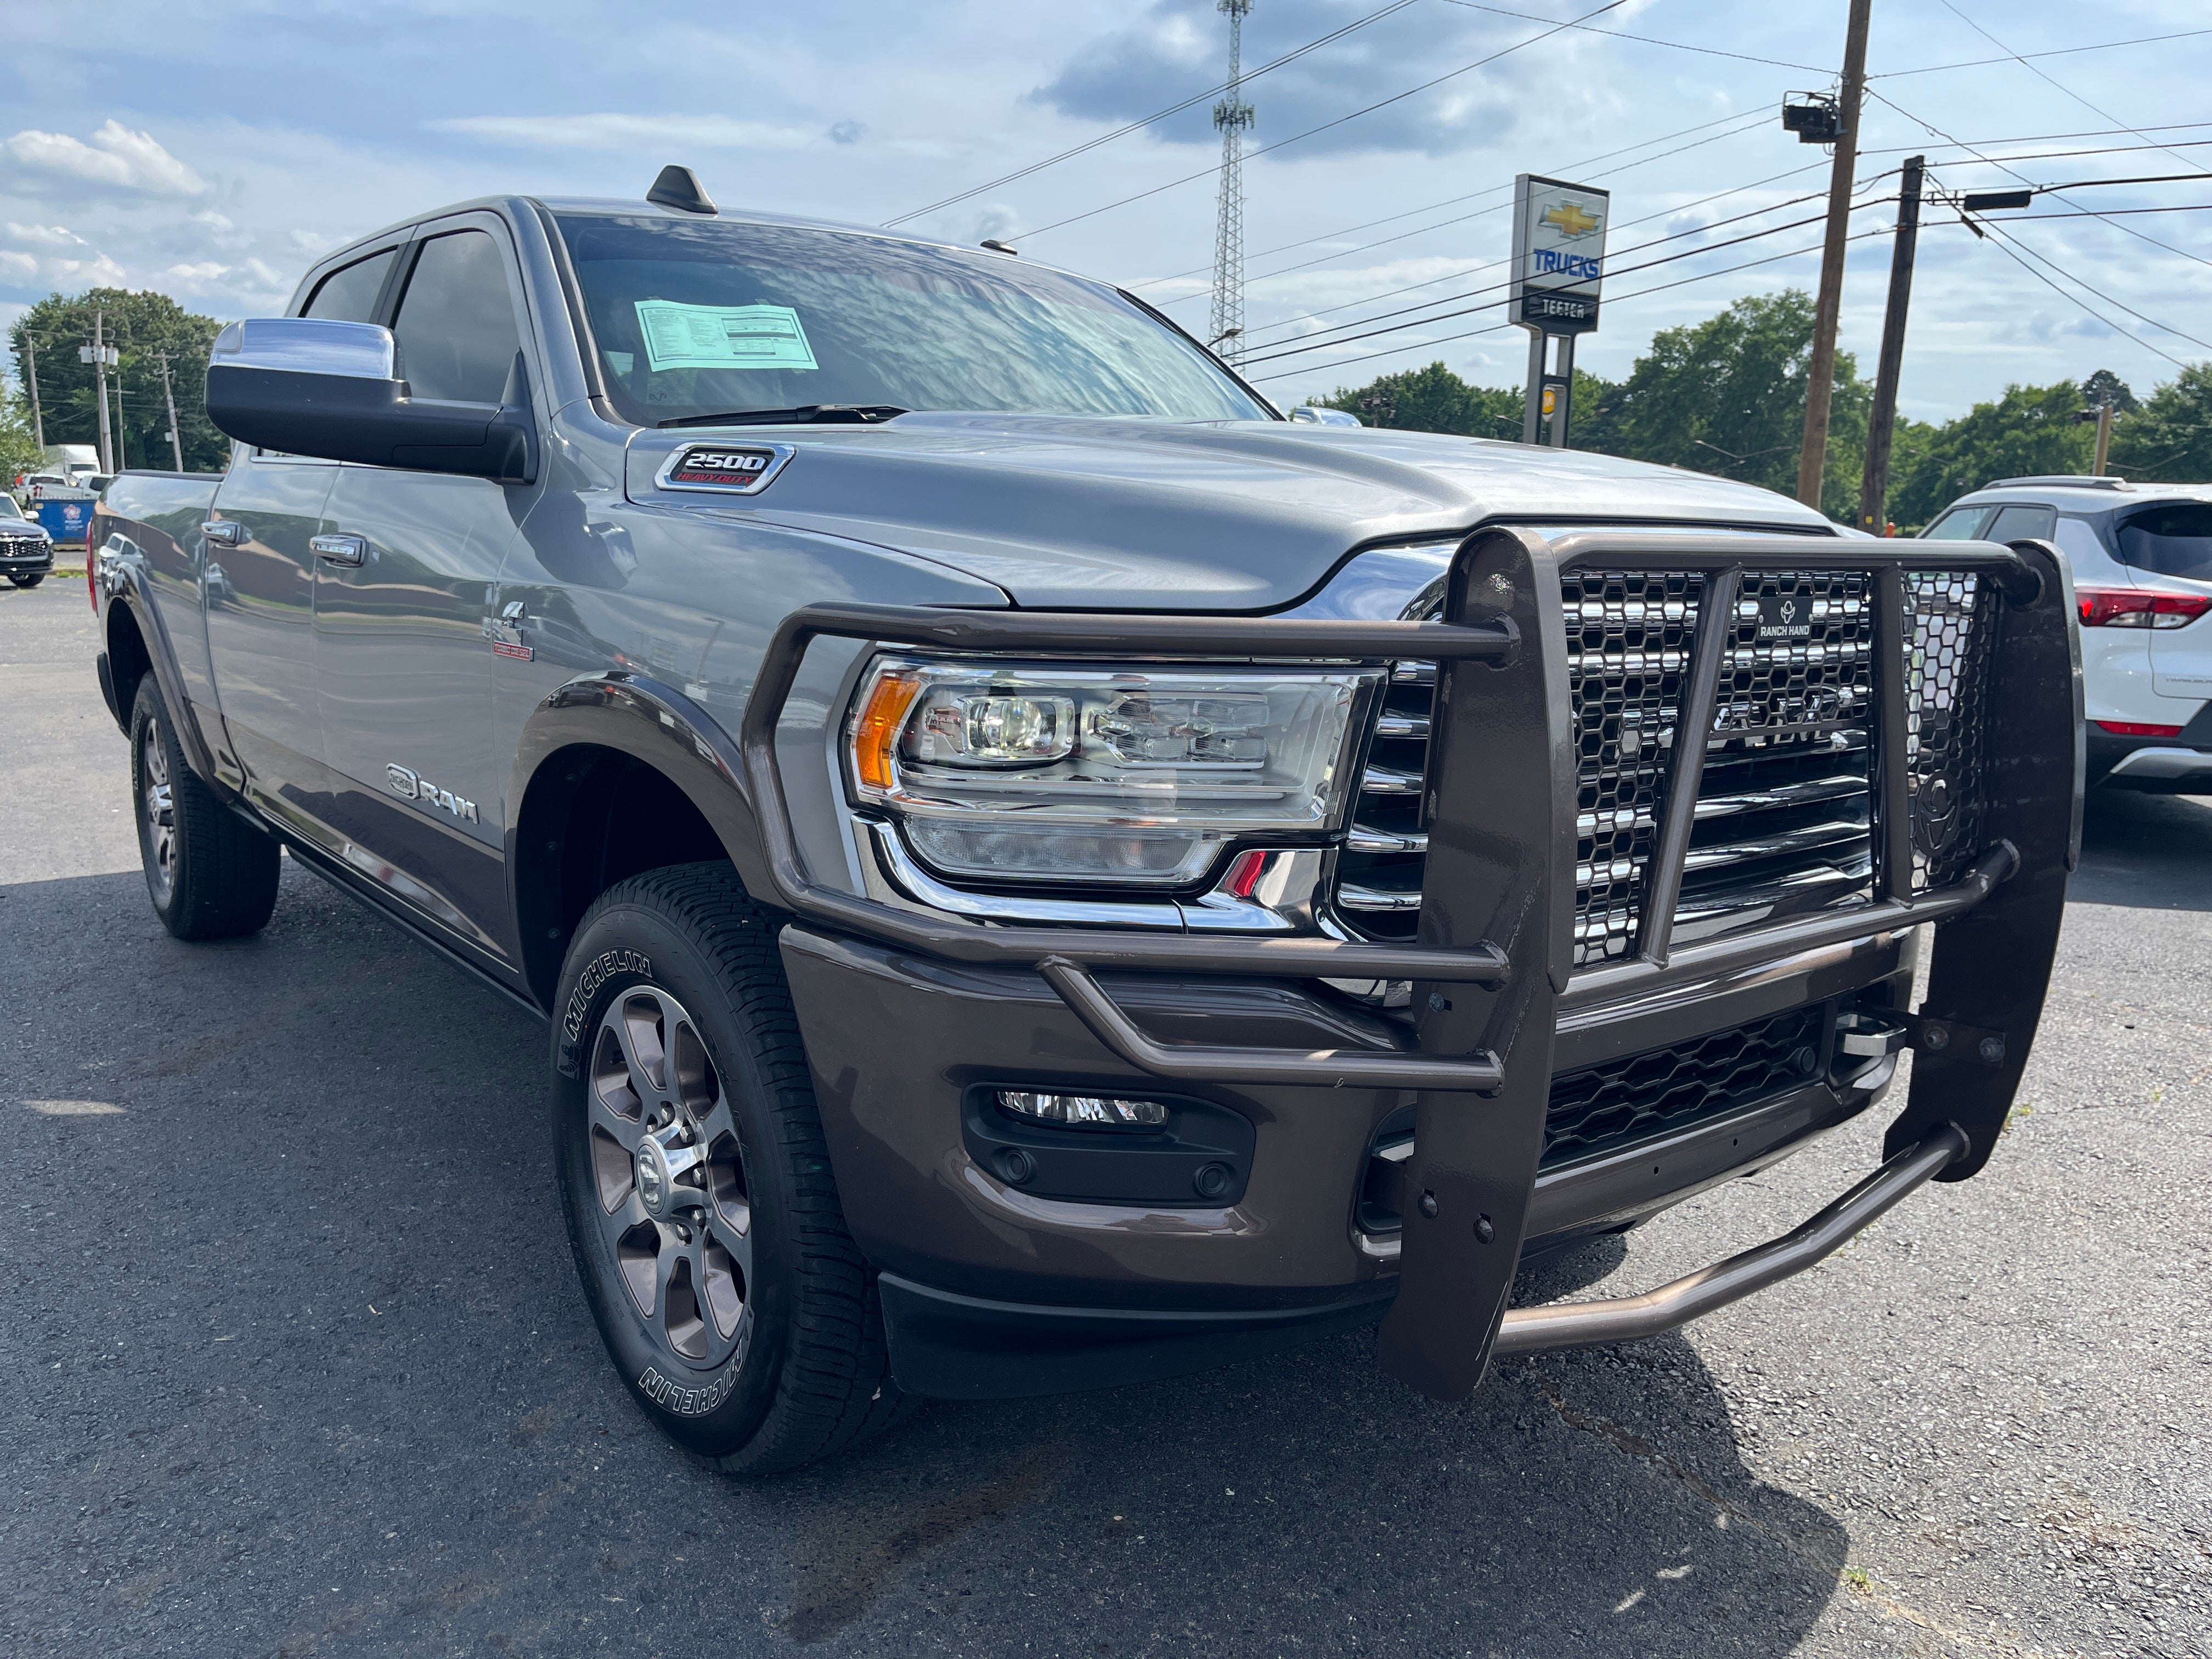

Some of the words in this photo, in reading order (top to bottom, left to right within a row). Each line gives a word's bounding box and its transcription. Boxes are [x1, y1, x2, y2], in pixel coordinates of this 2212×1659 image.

[1533, 249, 1599, 279] TRUCKS
[685, 453, 766, 471] 2500
[676, 472, 718, 482] HEAVY
[717, 475, 754, 483] DUTY
[1760, 626, 1788, 637] RANCH
[1788, 625, 1810, 636] HAND
[420, 780, 479, 825] RAM
[563, 950, 652, 1042] MICHELIN
[637, 1338, 743, 1414] MICHELIN
